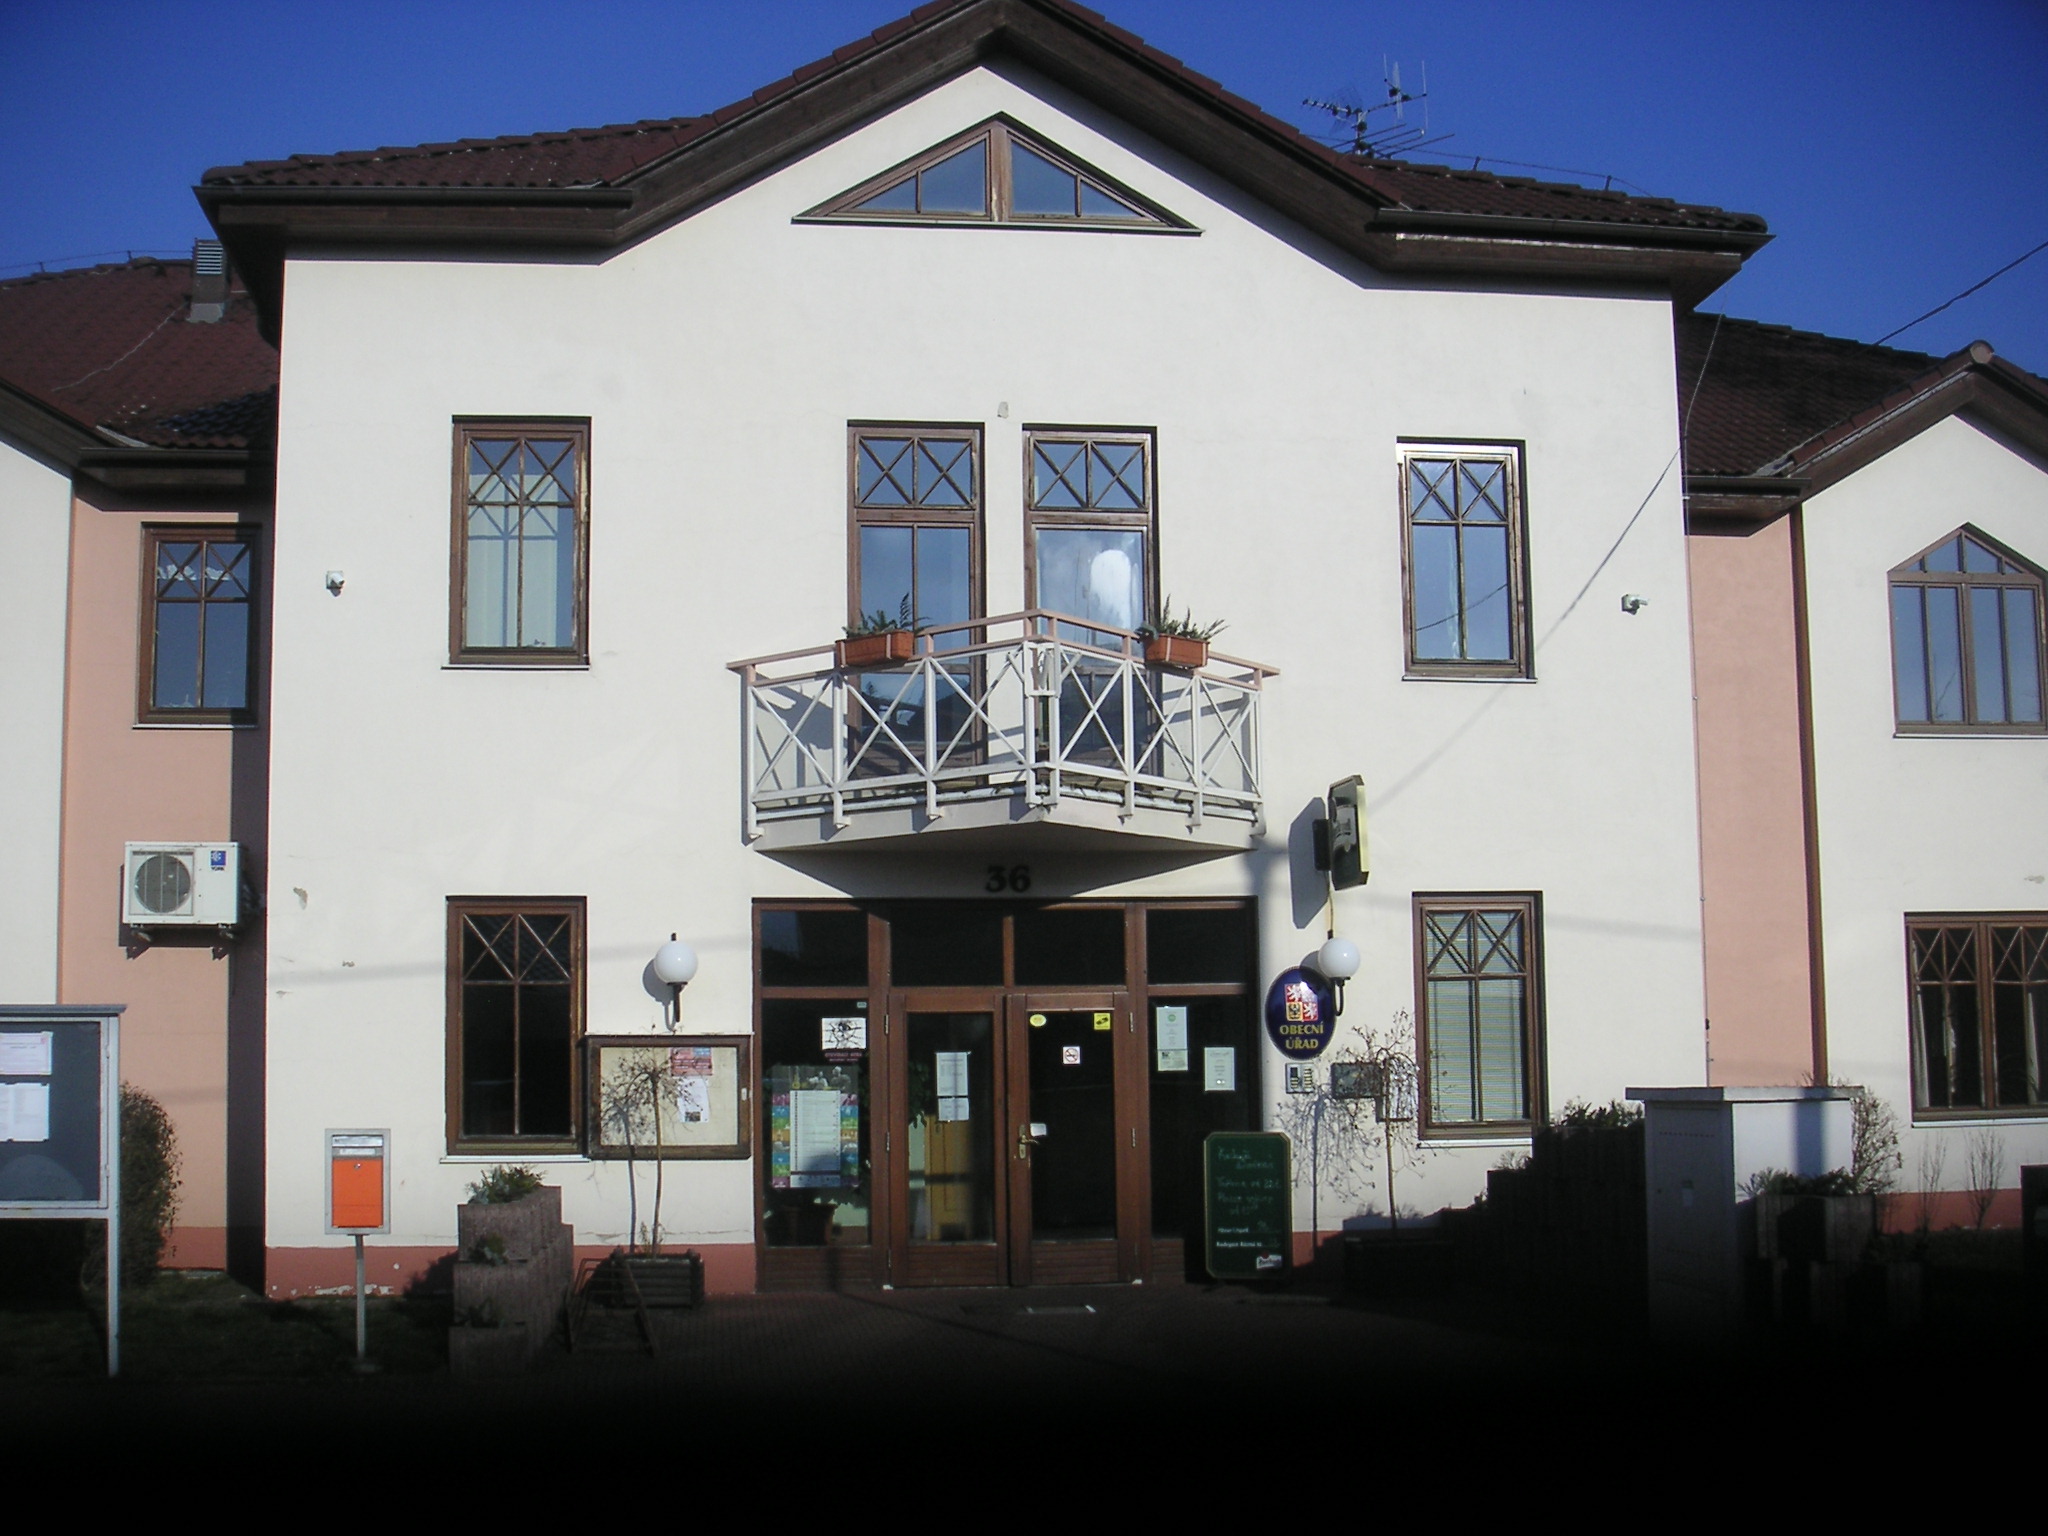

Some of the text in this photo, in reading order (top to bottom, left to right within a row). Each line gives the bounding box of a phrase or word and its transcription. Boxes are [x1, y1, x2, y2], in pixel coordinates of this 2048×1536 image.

[985, 864, 1031, 893] 36
[1279, 1021, 1324, 1035] OBECNÍ
[1285, 1037, 1319, 1049] ÚŘAD
